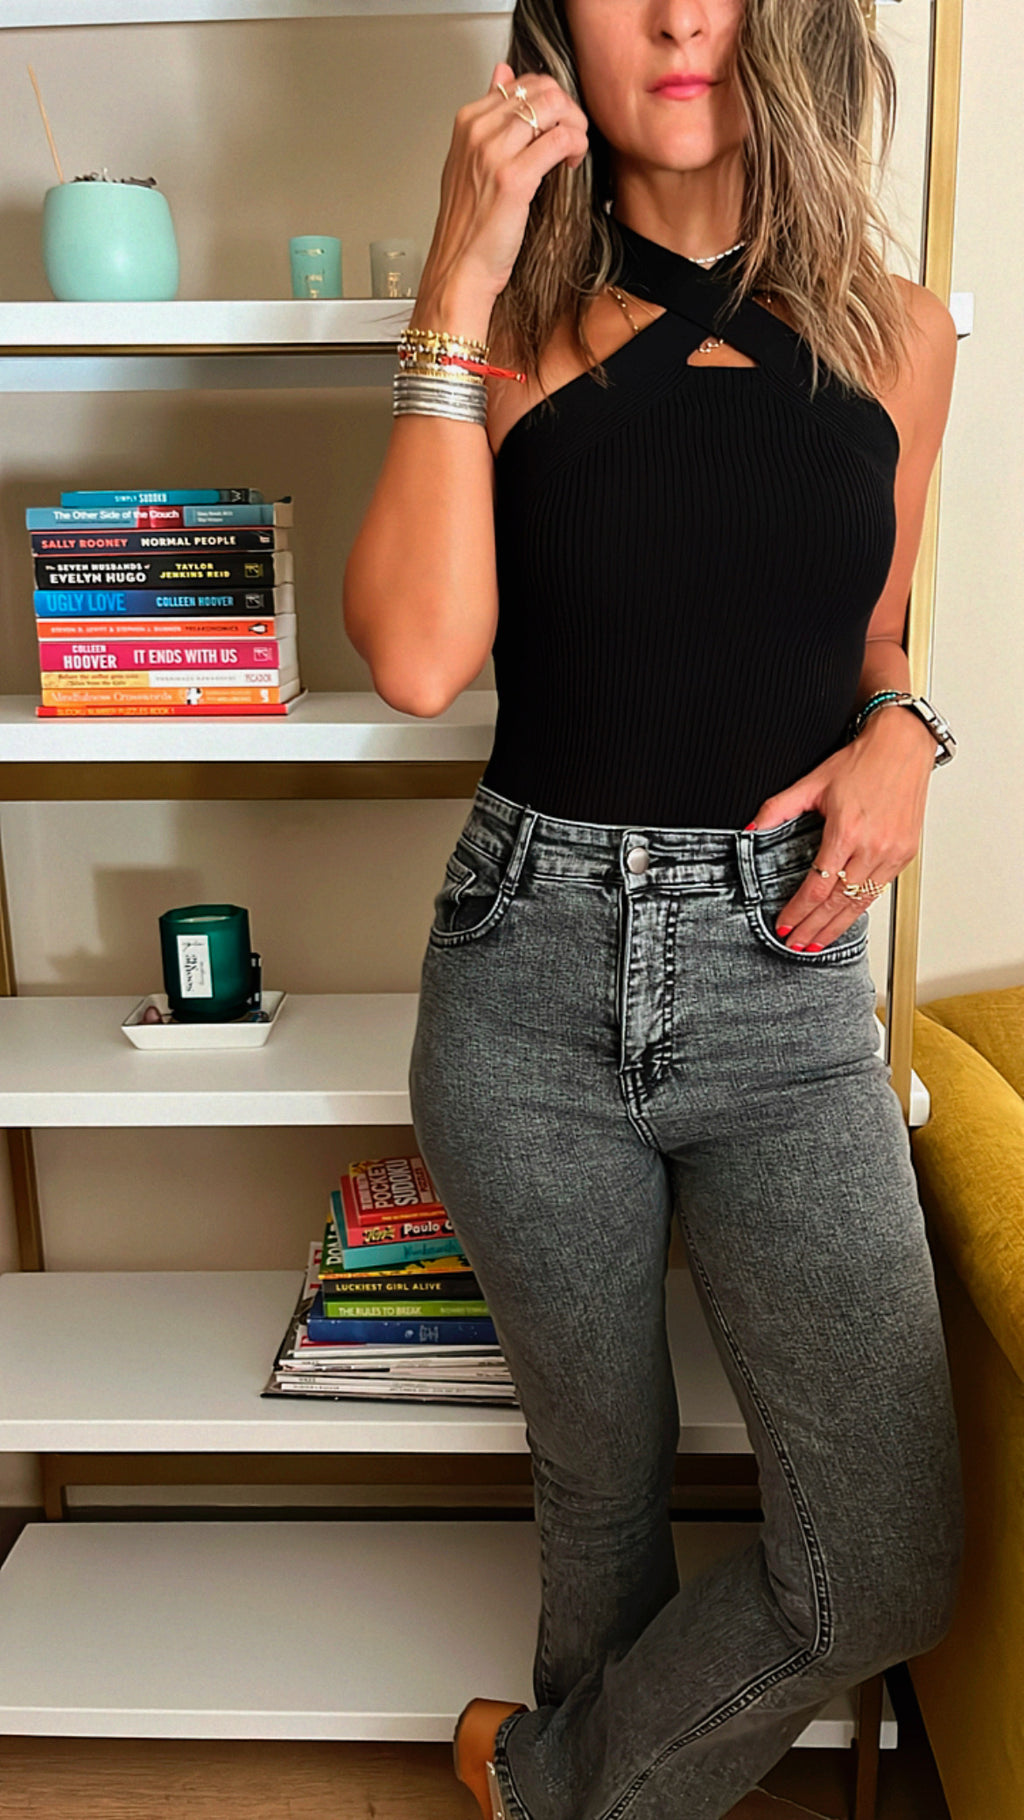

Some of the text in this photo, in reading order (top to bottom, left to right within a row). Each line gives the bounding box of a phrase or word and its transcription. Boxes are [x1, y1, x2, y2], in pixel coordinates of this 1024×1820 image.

[53, 510, 180, 520] The Other Side of the Couch
[41, 536, 237, 549] SALLY ROONEY NORMAL PEOPLE
[57, 564, 89, 572] SEVEN
[91, 563, 143, 571] HUSBANDS
[49, 571, 147, 584] EVELYN HUGO
[159, 570, 231, 579] JENKINS REID
[46, 592, 234, 612] UGLY LOVE COLLEEN HOOVER
[72, 645, 107, 653] COLLEEN
[63, 648, 238, 669] HOOVER IT ENDS WITH US
[368, 1162, 395, 1209] POCKET
[385, 1158, 419, 1206] SUDOKU
[403, 1221, 440, 1235] Paulo
[335, 1282, 442, 1292] LUCKIEST GIRL ALIVE
[338, 1307, 355, 1316] THE
[356, 1307, 381, 1316] RULES
[383, 1307, 395, 1315] TO
[395, 1306, 422, 1315] BREAK
